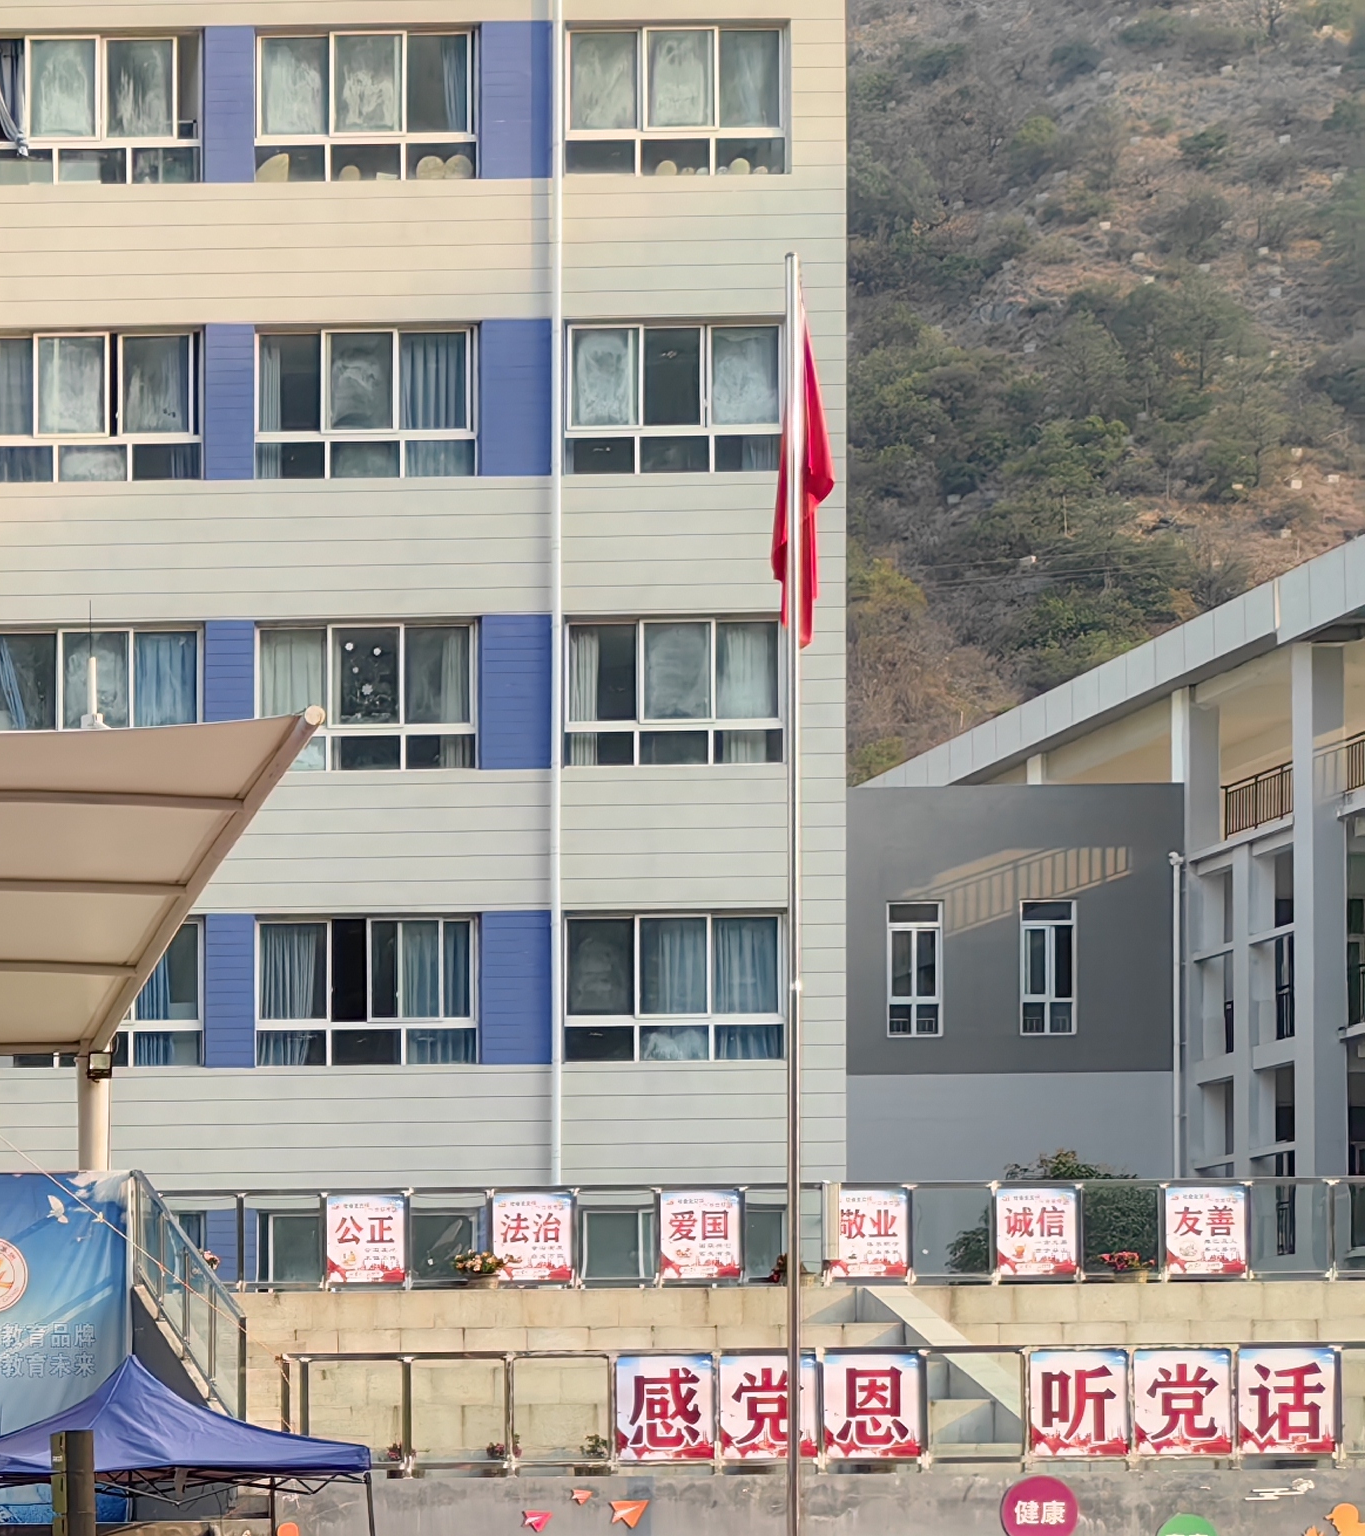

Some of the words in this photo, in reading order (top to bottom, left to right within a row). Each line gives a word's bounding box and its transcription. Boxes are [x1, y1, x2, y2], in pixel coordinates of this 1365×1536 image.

[335, 1215, 395, 1245] 公正
[500, 1212, 561, 1244] 法治
[669, 1209, 729, 1241] 爱国
[840, 1208, 898, 1240] 敬业
[1004, 1206, 1066, 1238] 诚信
[1173, 1205, 1236, 1237] 友善
[628, 1365, 910, 1449] 感党恩
[1041, 1362, 1326, 1442] 听党话
[1014, 1500, 1066, 1526] 健康
